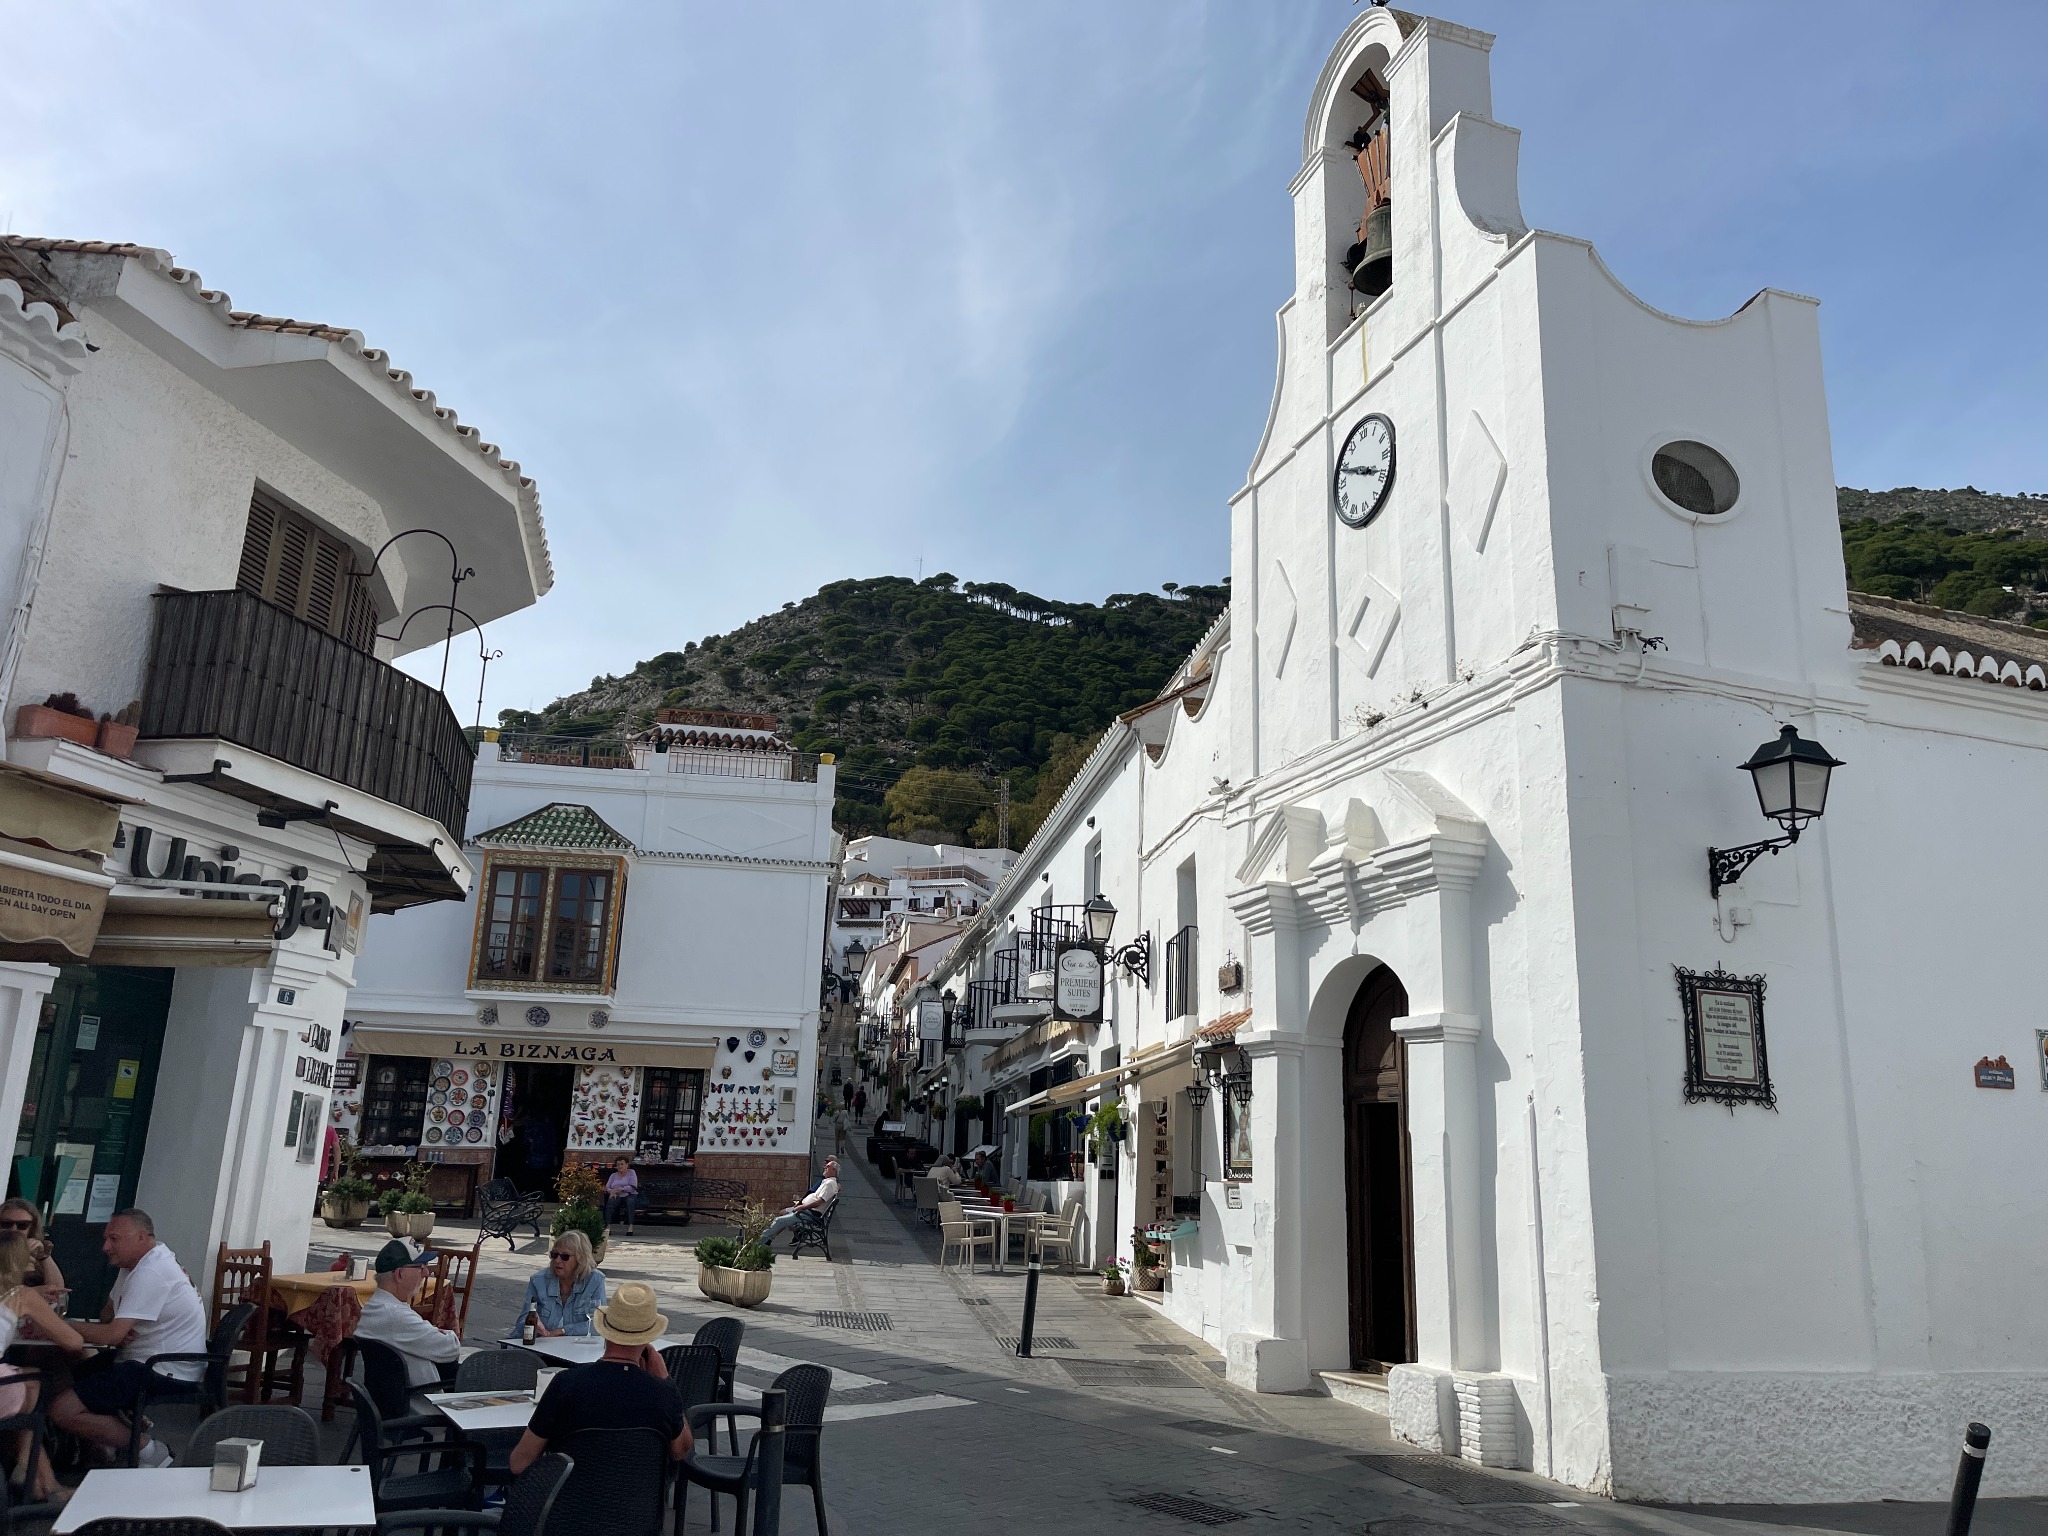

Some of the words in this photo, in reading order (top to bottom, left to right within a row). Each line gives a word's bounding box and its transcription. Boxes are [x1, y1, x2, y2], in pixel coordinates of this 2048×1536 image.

[131, 826, 331, 940] Unicaja
[0, 885, 34, 900] BIERTA
[36, 893, 61, 905] TODO
[62, 899, 73, 908] EL
[75, 901, 92, 911] DIA
[13, 900, 30, 910] ALL
[31, 903, 49, 914] DAY
[49, 908, 76, 920] OPEN
[1060, 978, 1099, 989] PREMIERE
[1067, 989, 1091, 998] SUITES
[454, 1040, 488, 1056] LA
[499, 1043, 617, 1062] BIZNAGA
